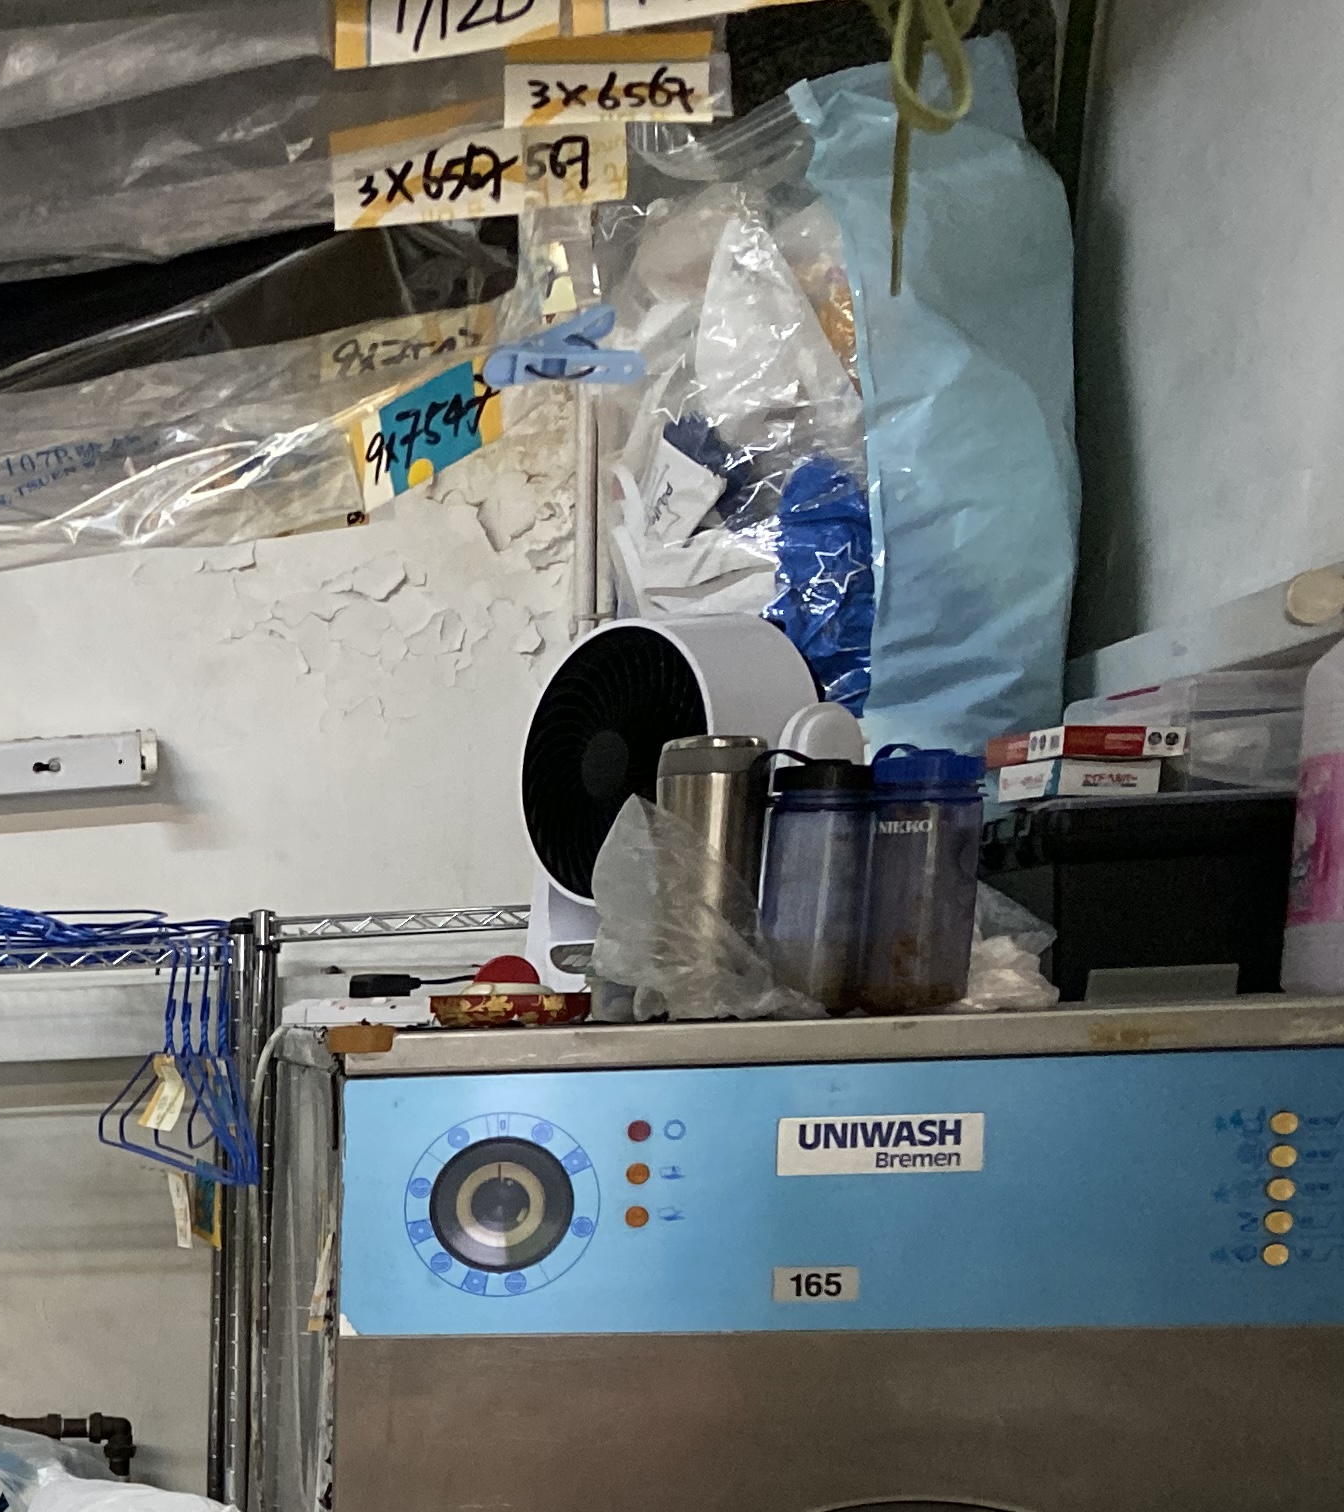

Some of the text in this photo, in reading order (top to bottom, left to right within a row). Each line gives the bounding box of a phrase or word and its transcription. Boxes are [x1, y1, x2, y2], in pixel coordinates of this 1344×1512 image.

[798, 1119, 962, 1150] UNIWASH
[875, 1151, 962, 1169] Bremen
[790, 1272, 843, 1298] 165
